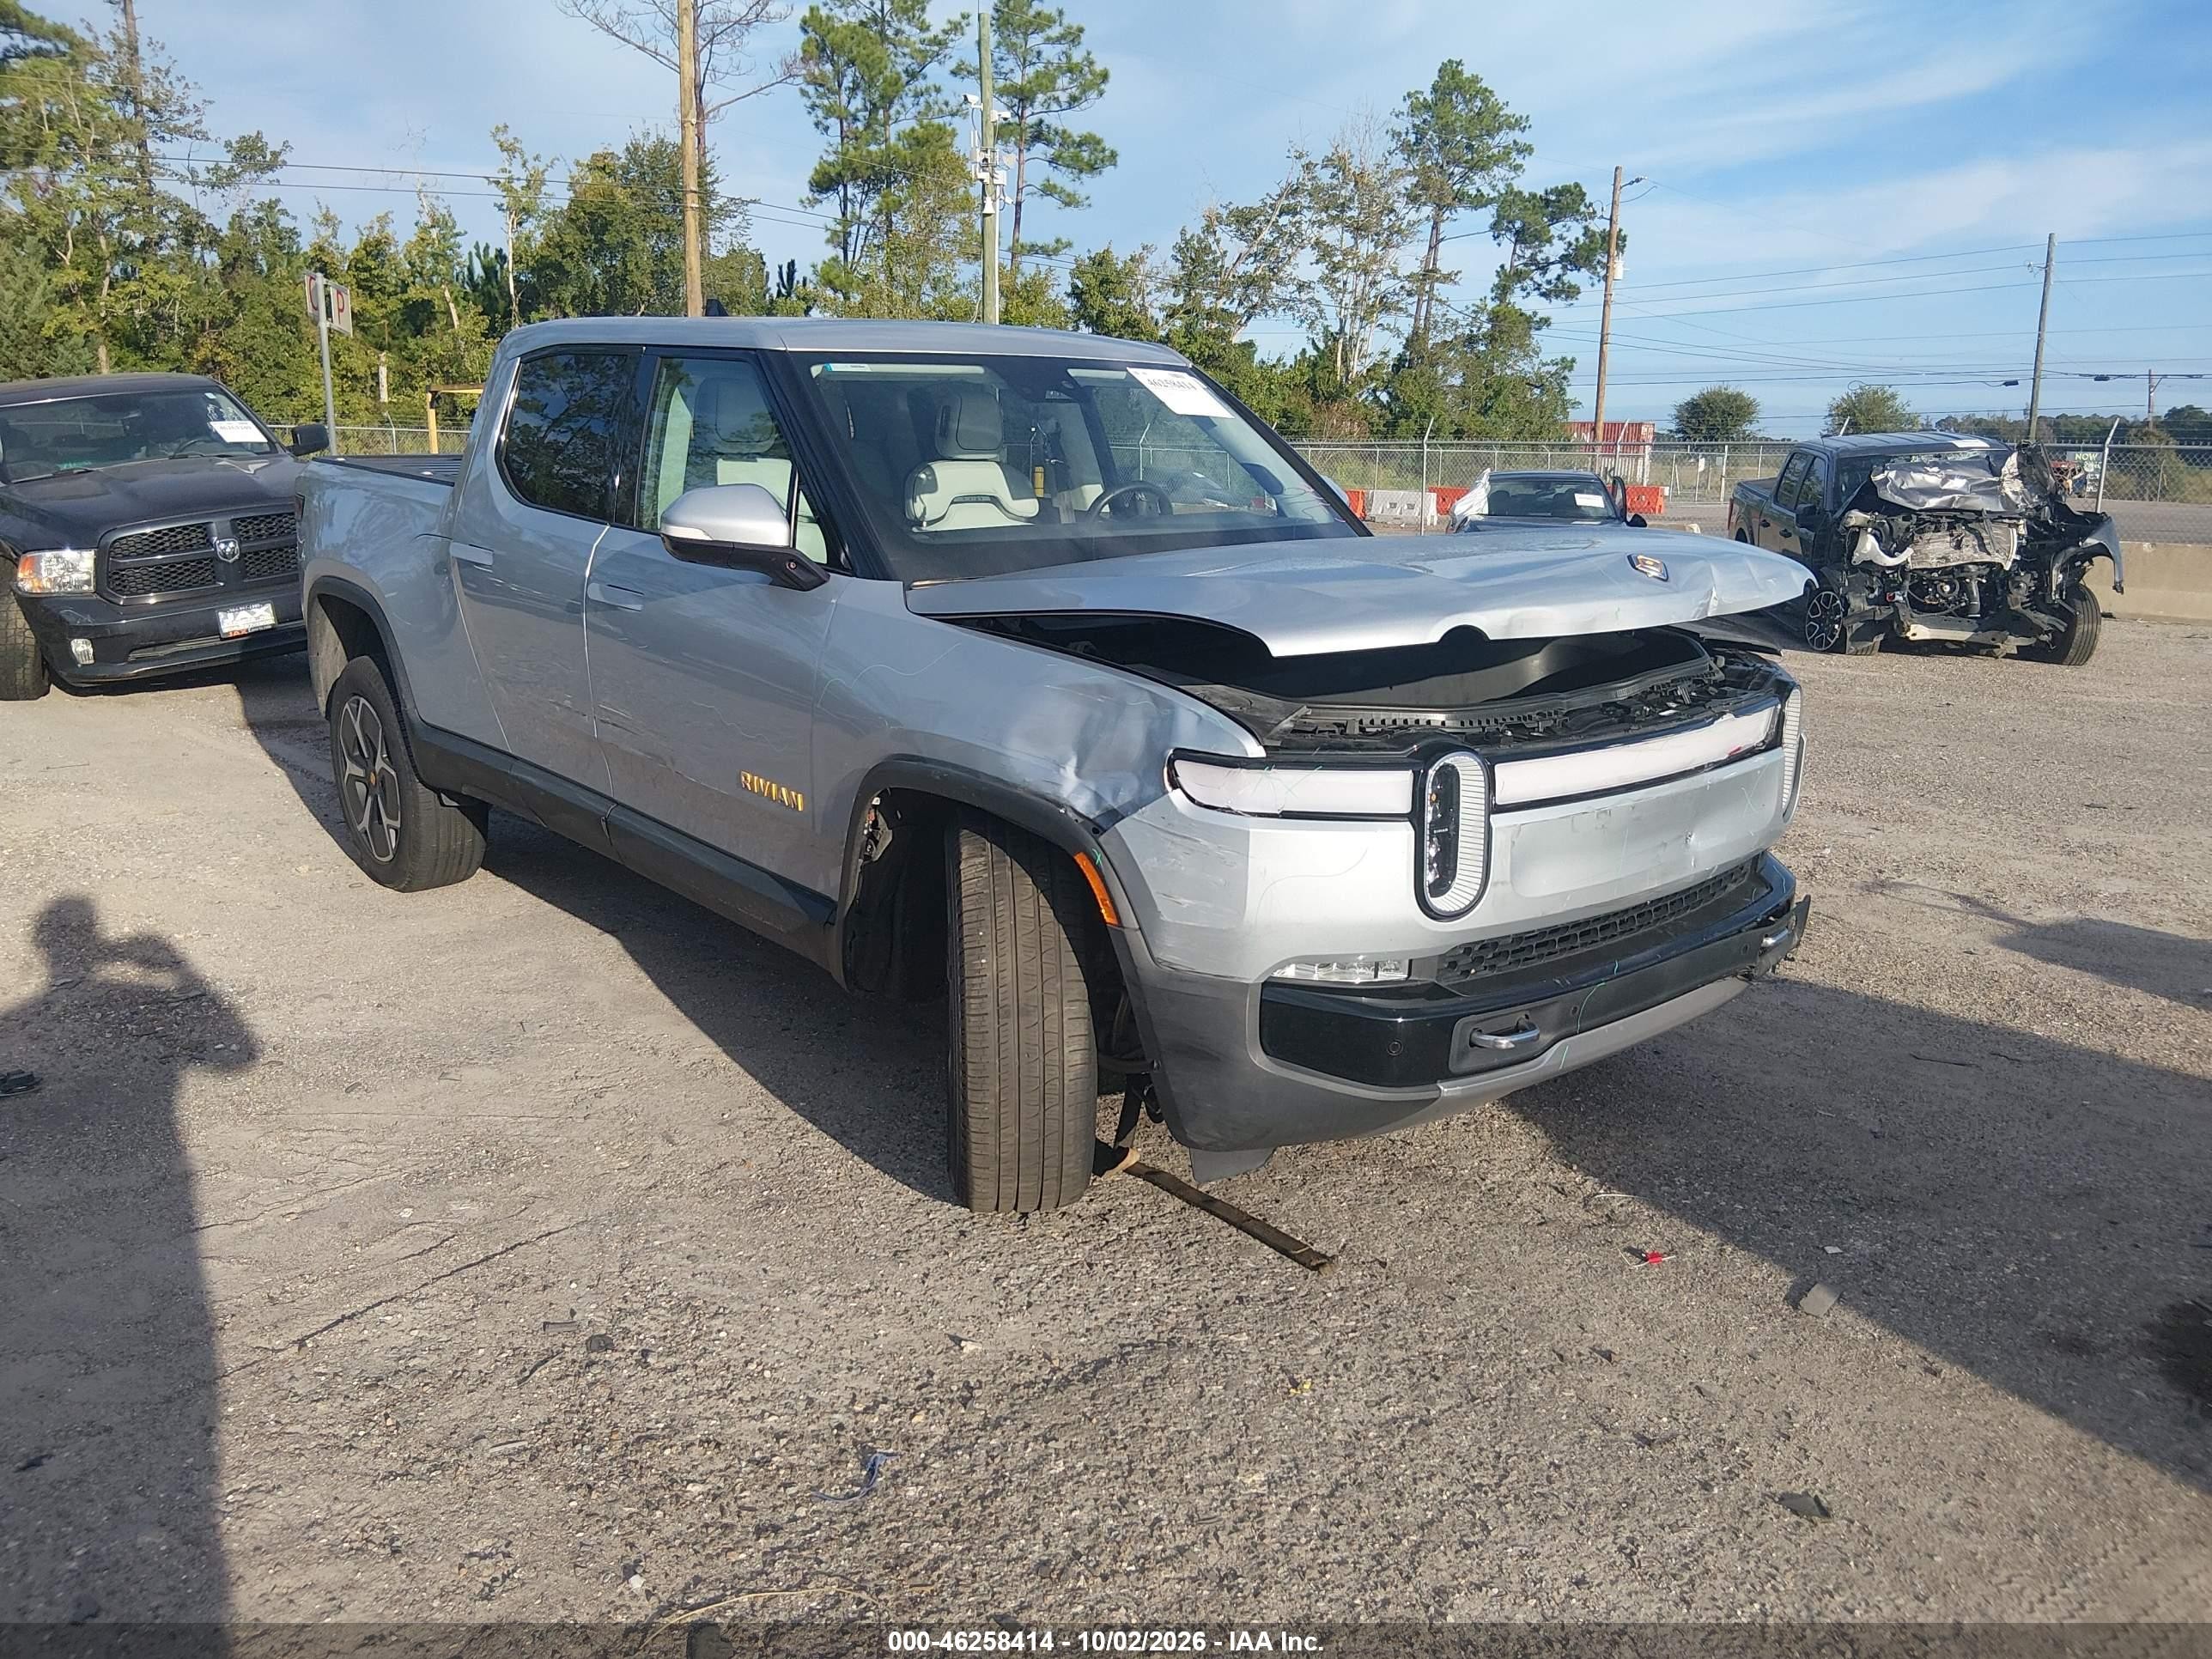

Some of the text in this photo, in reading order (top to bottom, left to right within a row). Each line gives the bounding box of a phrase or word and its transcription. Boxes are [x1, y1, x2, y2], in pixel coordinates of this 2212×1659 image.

[336, 289, 345, 325] P
[2075, 453, 2098, 461] NOW
[228, 628, 248, 637] JAX
[739, 770, 805, 811] RIVIAN
